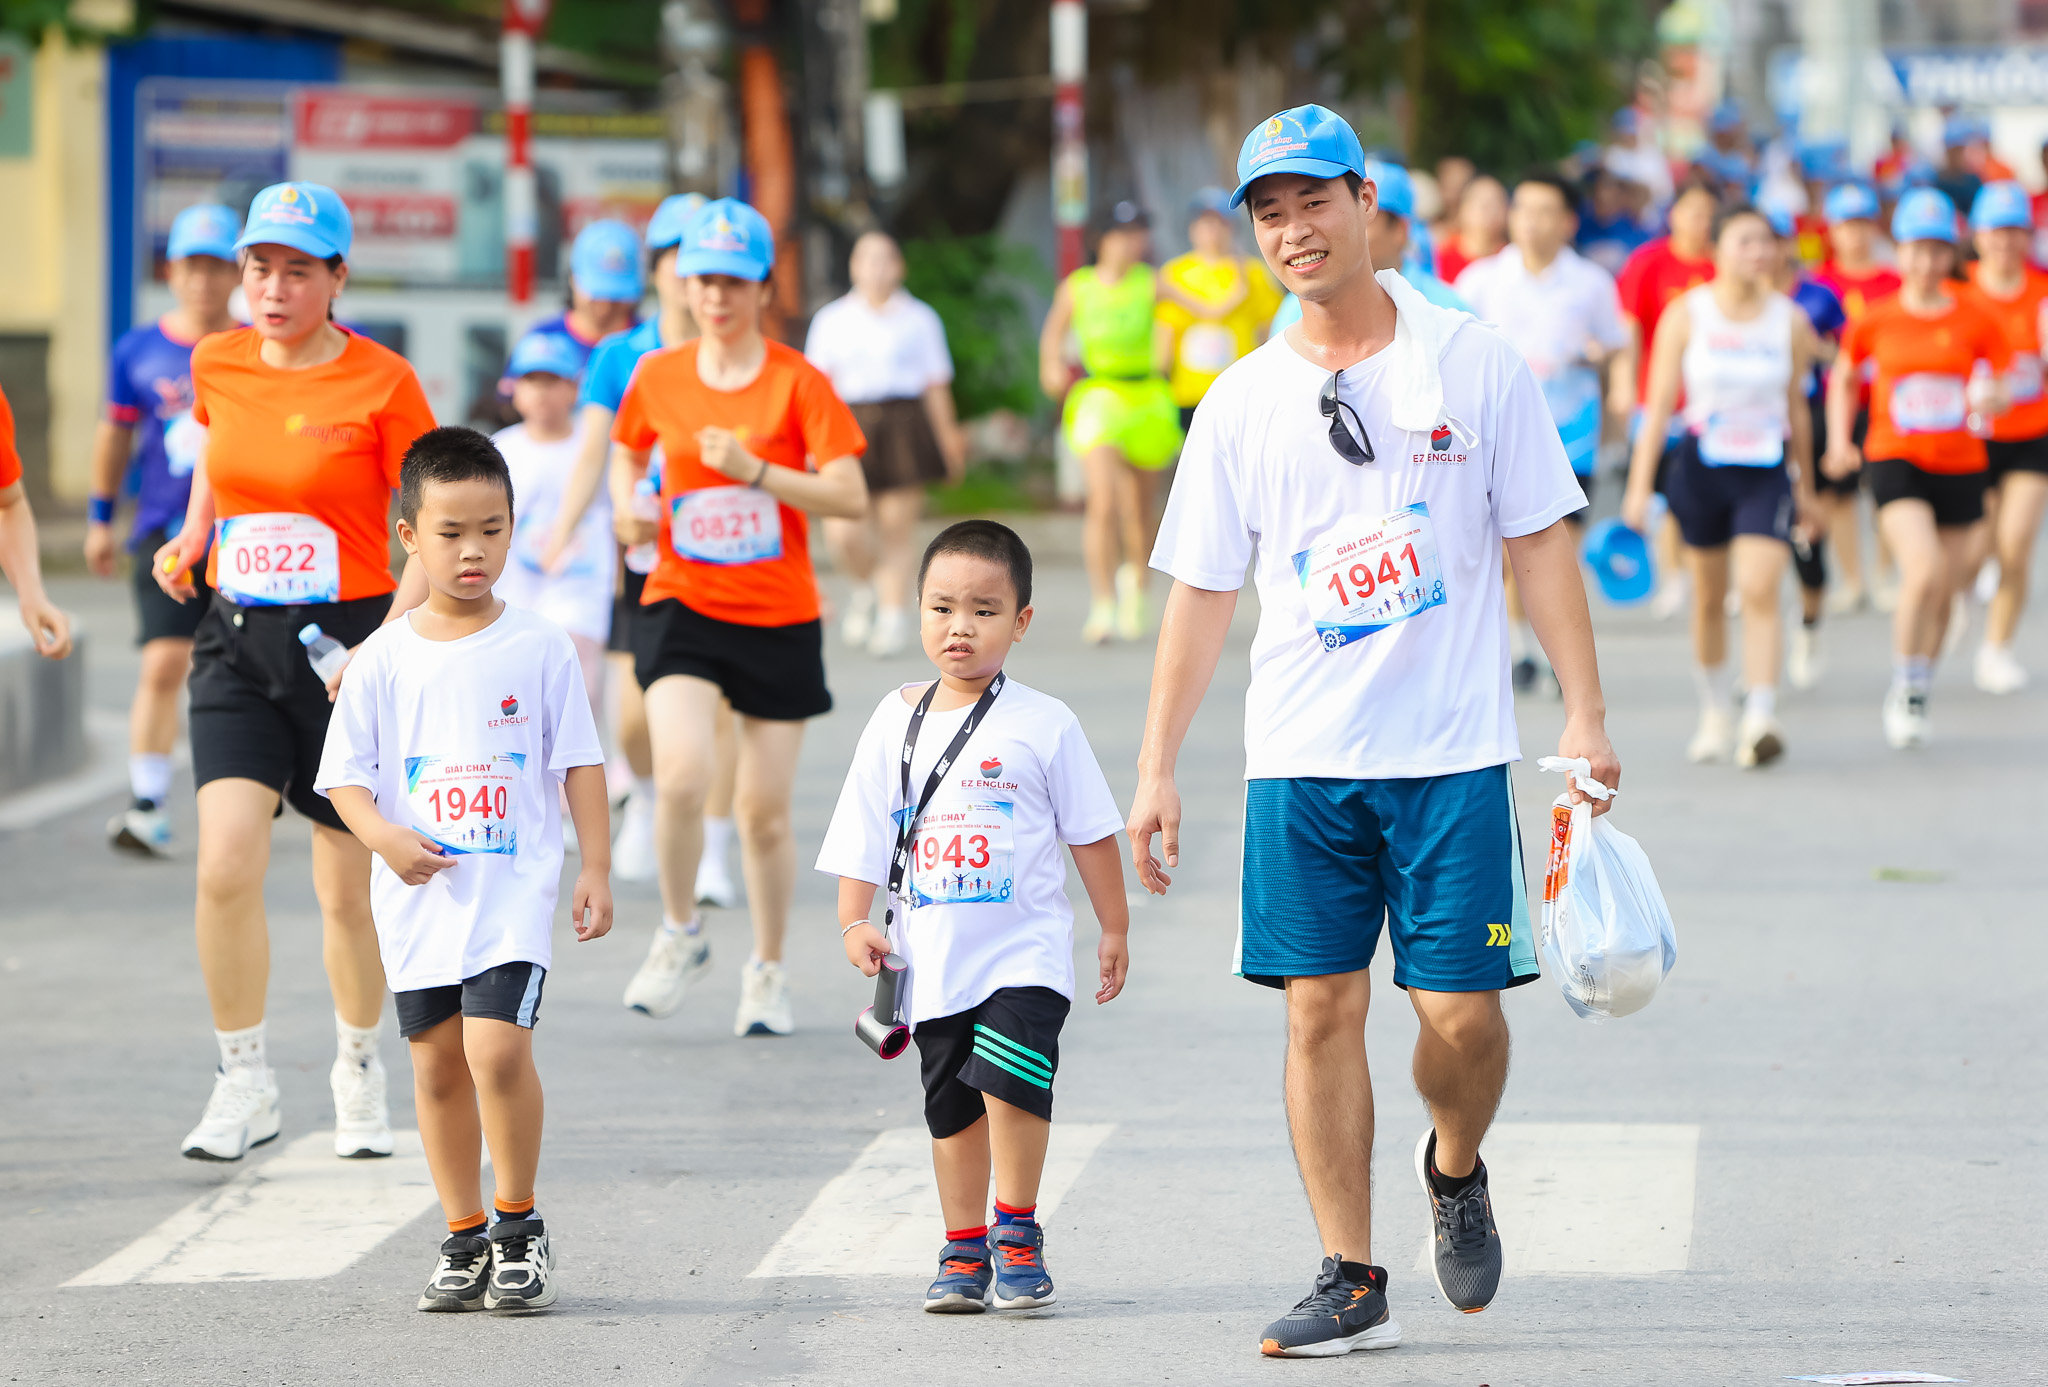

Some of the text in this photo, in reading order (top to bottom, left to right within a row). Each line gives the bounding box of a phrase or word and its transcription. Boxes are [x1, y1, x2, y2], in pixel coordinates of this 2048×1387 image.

[1412, 453, 1467, 463] EZ ENGLISH
[690, 511, 761, 542] 0821
[236, 543, 315, 575] 0822
[1327, 542, 1421, 607] 1941
[990, 678, 1002, 697] NIKE
[487, 720, 499, 728] EZ
[902, 741, 913, 765] NIKE
[934, 755, 951, 778] NIKE
[961, 780, 974, 788] EZ
[976, 780, 1018, 790] ENGLISH
[428, 785, 507, 823] 1940
[911, 834, 990, 873] 1943
